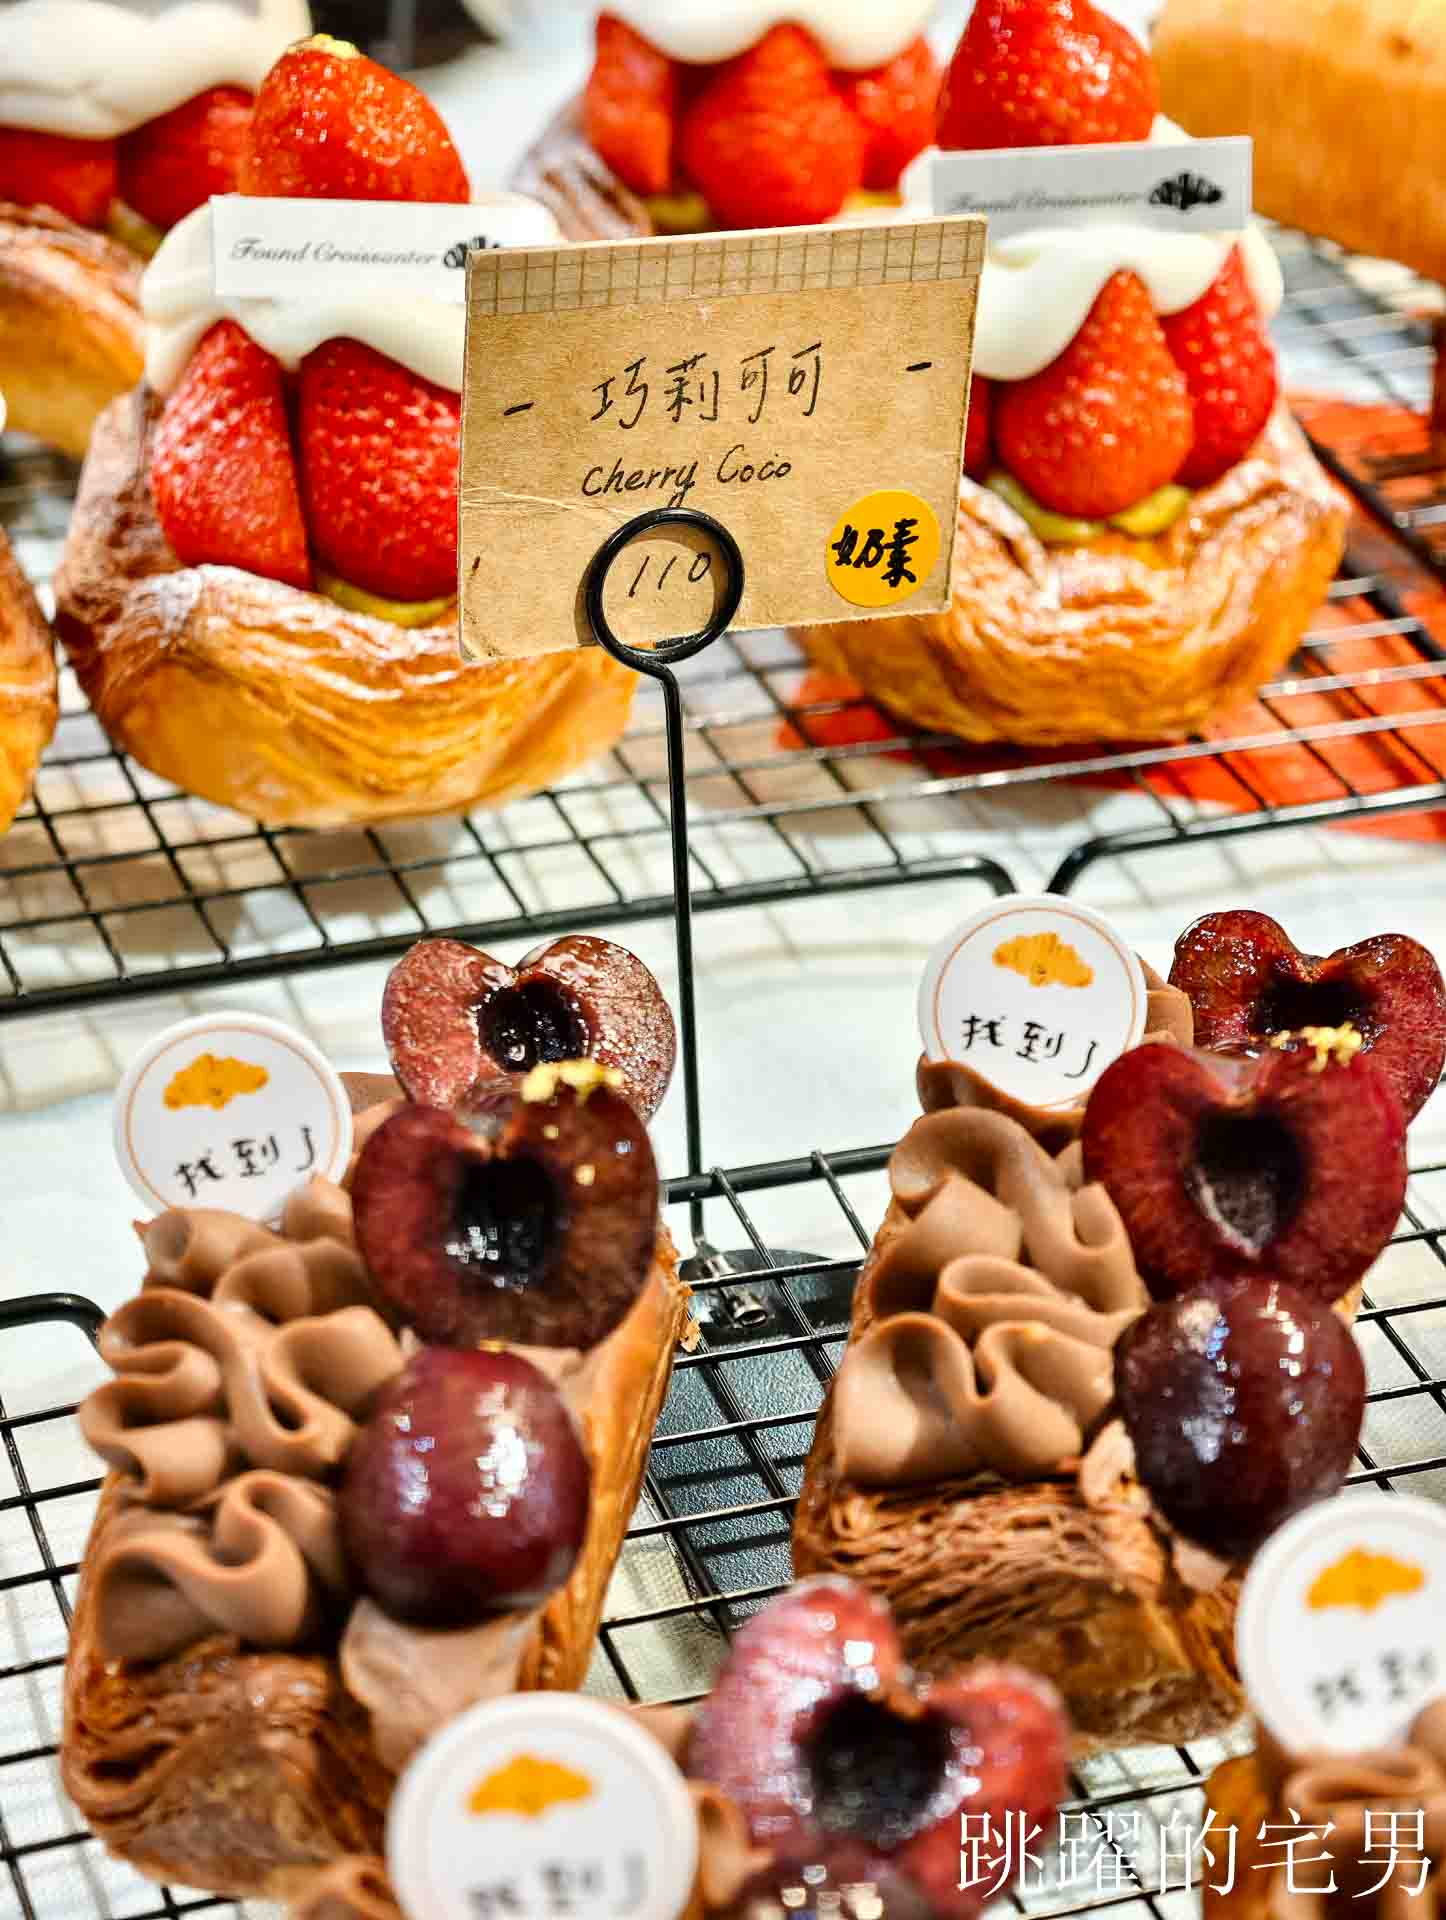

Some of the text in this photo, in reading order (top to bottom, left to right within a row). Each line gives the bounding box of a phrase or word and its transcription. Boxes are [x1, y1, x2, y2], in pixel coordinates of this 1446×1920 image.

[590, 341, 823, 429] 巧莉可可
[716, 445, 793, 484] Coco
[627, 551, 713, 599] 110
[831, 518, 920, 588] 奶素
